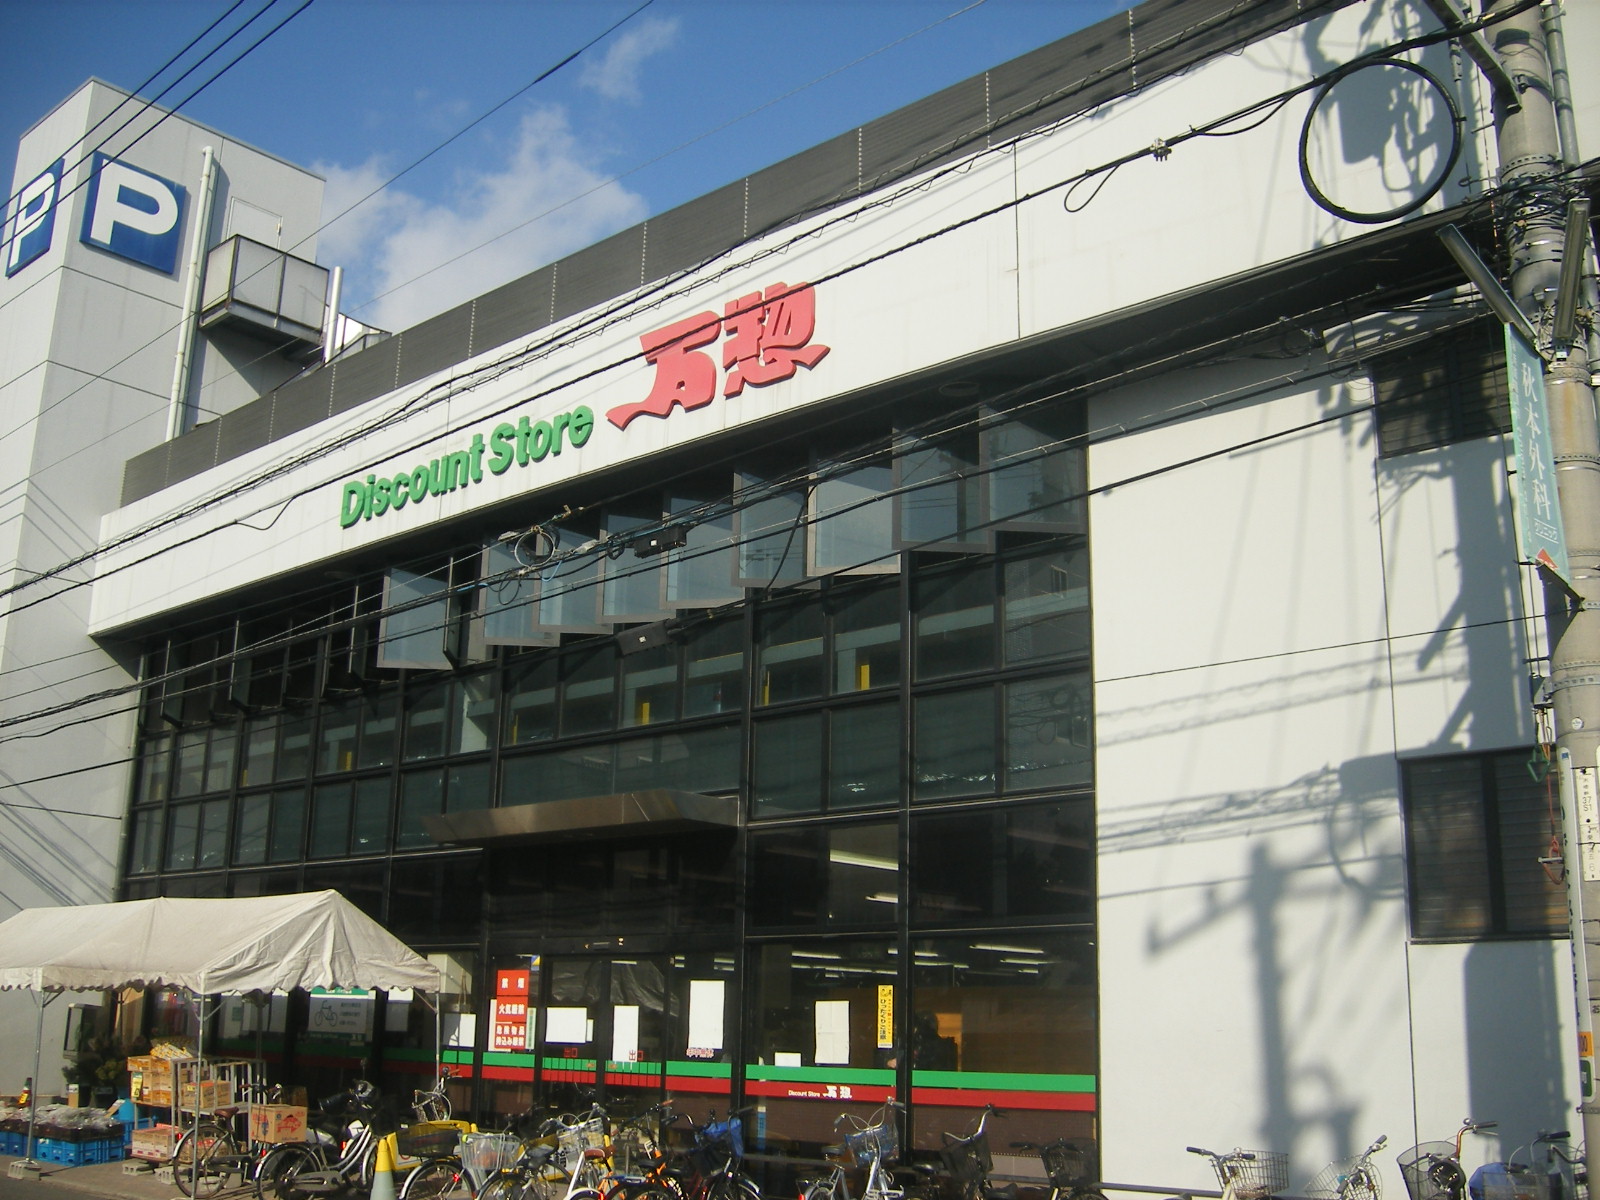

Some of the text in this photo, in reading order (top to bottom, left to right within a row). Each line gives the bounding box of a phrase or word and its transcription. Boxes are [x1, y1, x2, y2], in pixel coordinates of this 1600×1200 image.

[9, 171, 55, 268] P
[90, 159, 178, 245] P
[340, 281, 830, 528] Discount Store 万惣
[1522, 362, 1551, 520] 秋本外科
